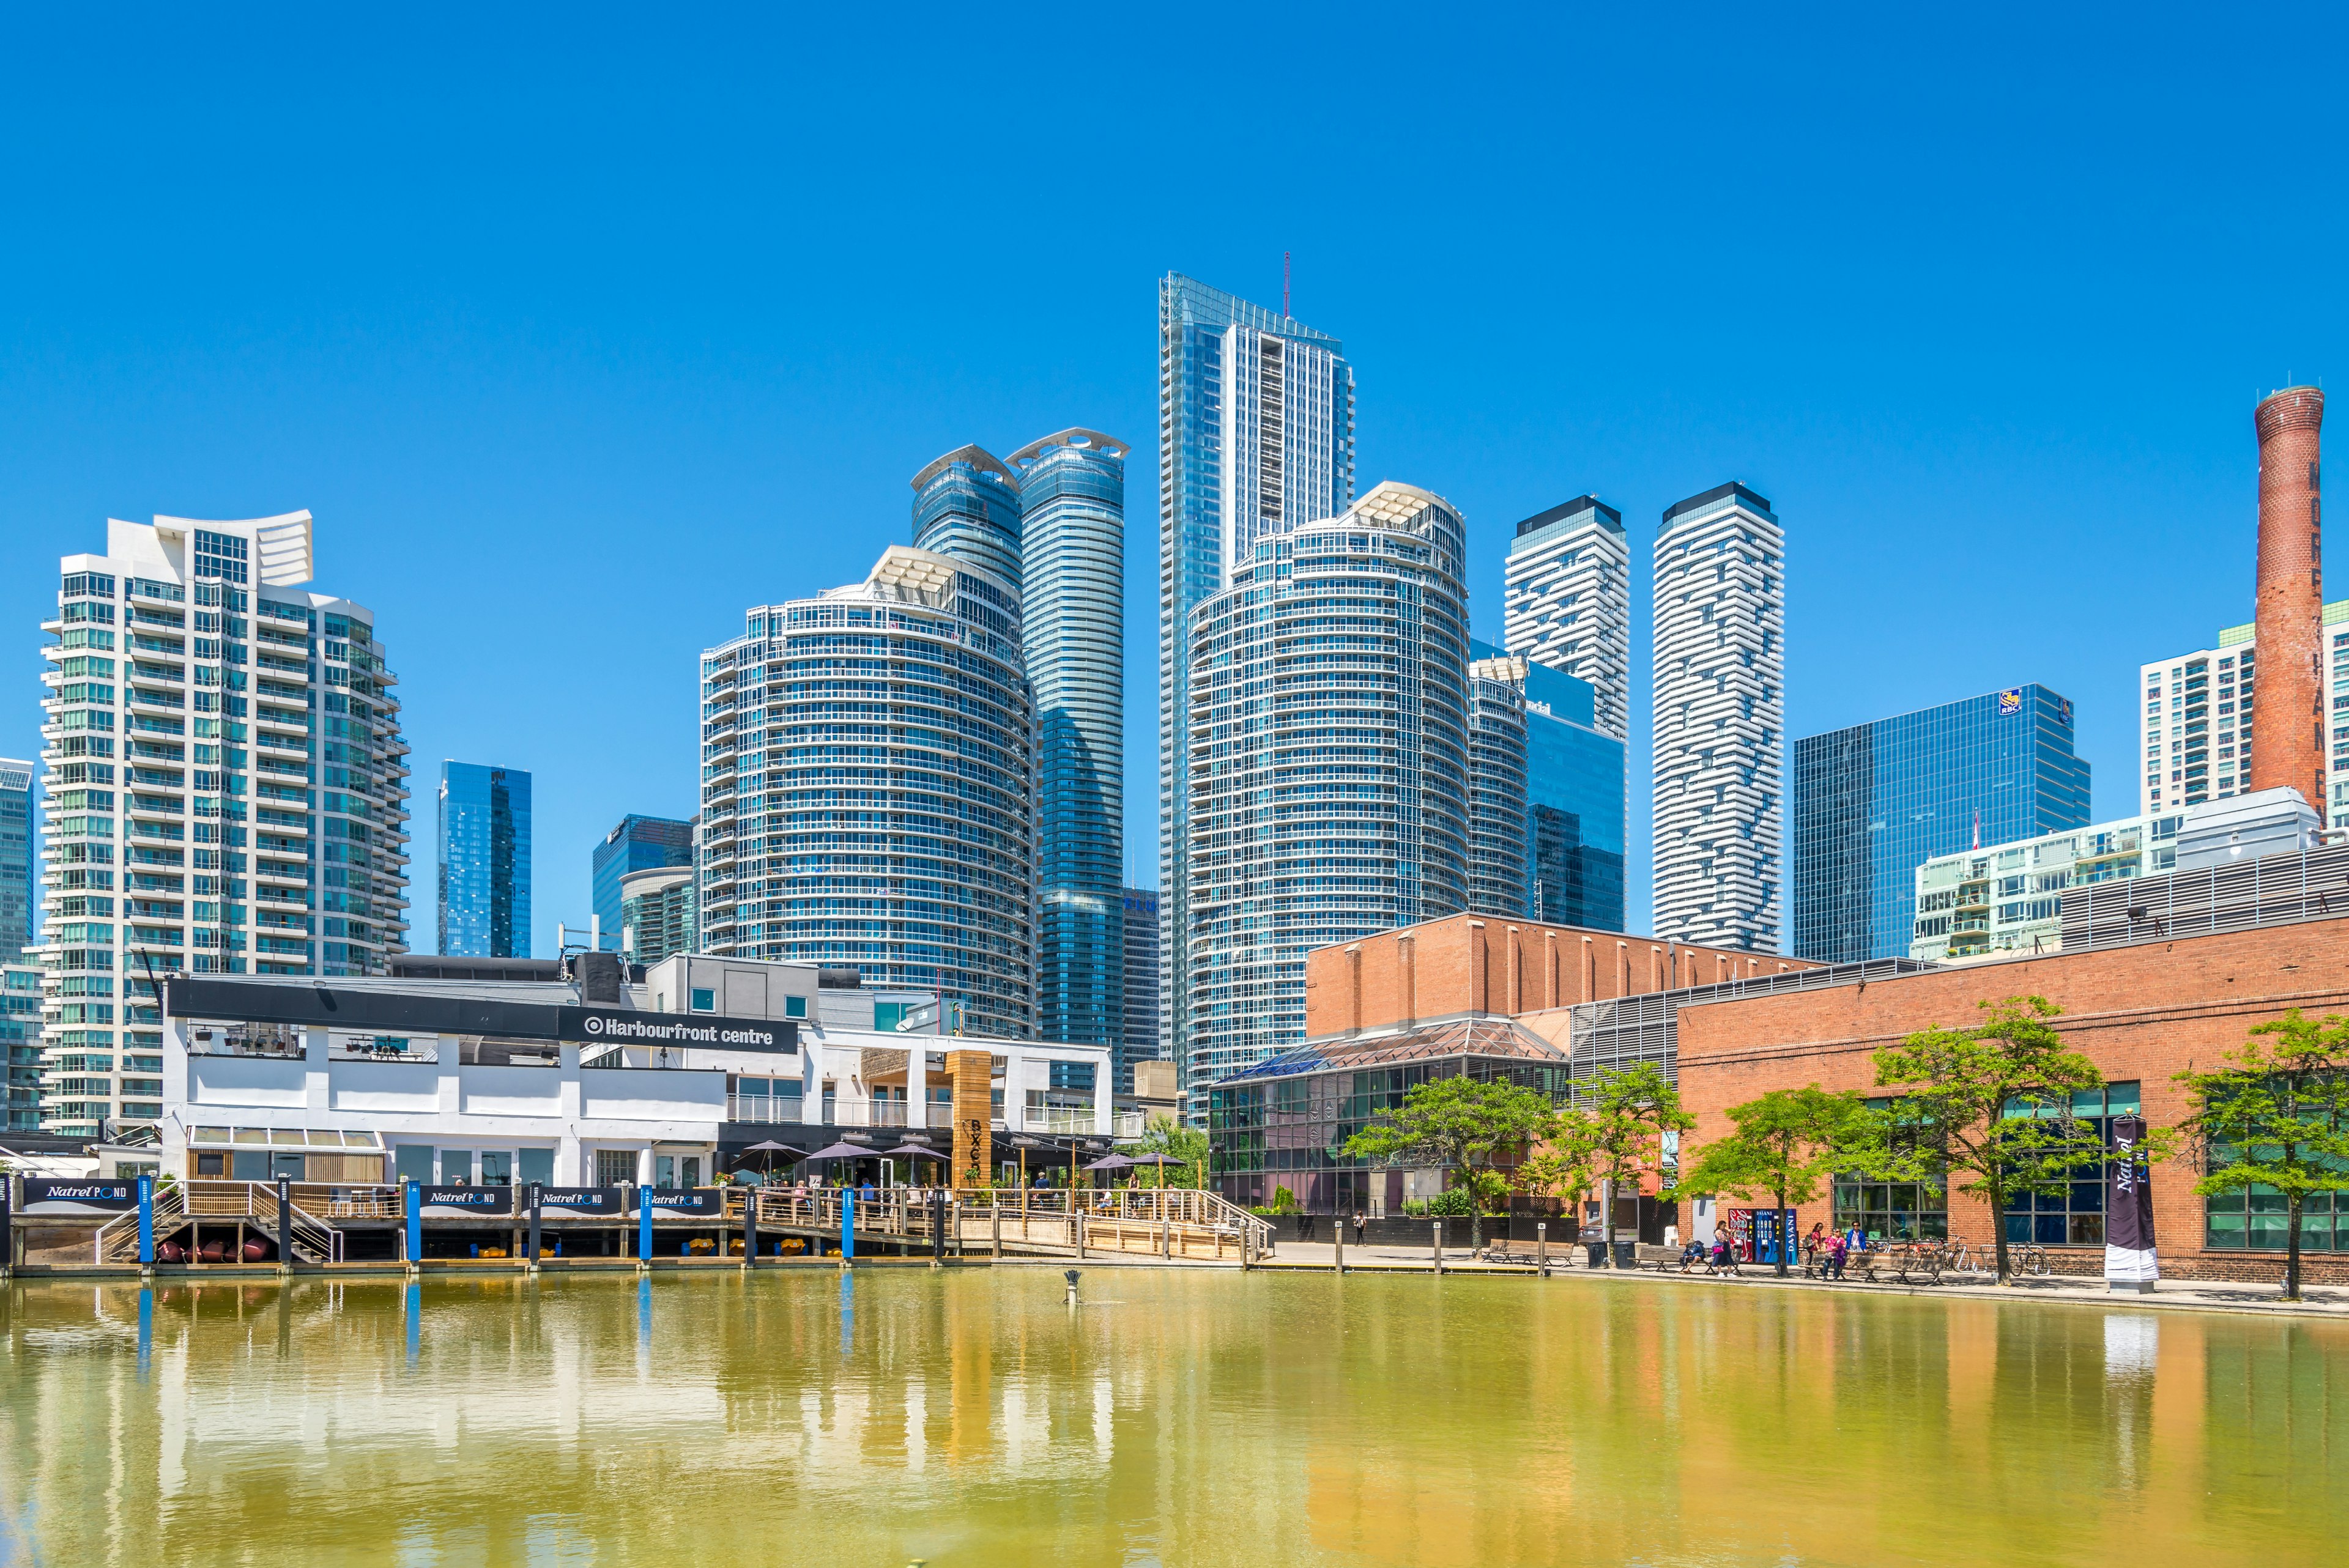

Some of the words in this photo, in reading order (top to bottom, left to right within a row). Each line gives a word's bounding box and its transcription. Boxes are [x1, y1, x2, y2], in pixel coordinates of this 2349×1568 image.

[2002, 705, 2018, 714] RBC
[606, 1019, 718, 1042] Harbourfront
[721, 1029, 773, 1045] centre
[46, 1186, 91, 1197] Natrel
[94, 1187, 127, 1199] POND
[429, 1193, 467, 1202] Natrel
[469, 1193, 495, 1204] POND
[541, 1194, 576, 1204] Natrel
[577, 1194, 602, 1205] POND
[680, 1196, 703, 1206] POND
